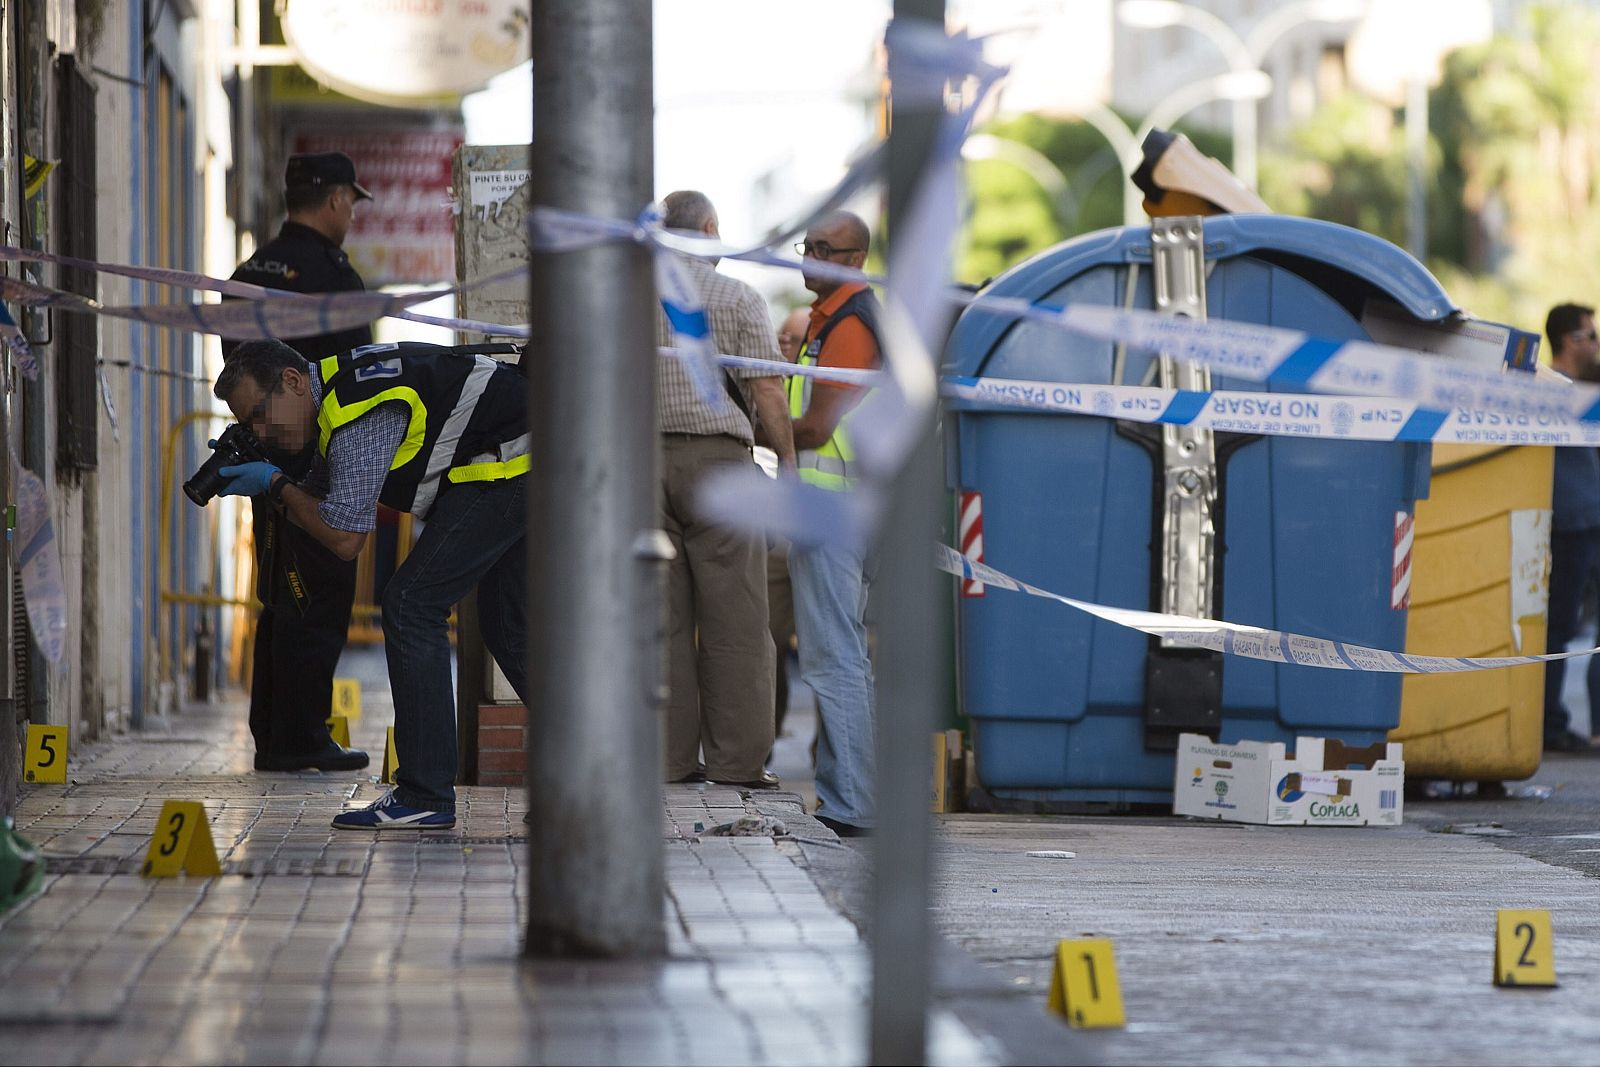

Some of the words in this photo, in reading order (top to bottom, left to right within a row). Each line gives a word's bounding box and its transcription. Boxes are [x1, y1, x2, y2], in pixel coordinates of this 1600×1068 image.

[474, 174, 501, 183] PINTE
[504, 173, 516, 182] SU
[491, 185, 507, 193] POR
[1053, 388, 1082, 406] NO
[1121, 400, 1162, 411] CNP
[1213, 399, 1282, 416] PASAR
[1289, 401, 1319, 418] NO
[1360, 409, 1403, 422] CNP
[1457, 406, 1530, 426] PASAR
[1263, 422, 1281, 431] DE
[1455, 430, 1507, 441] POLICIA
[1511, 431, 1529, 440] DE
[1531, 431, 1570, 443] LINEA
[287, 571, 305, 600] Nikon
[37, 734, 57, 768] 5
[160, 812, 185, 857] 3
[1514, 922, 1537, 968] 2
[1082, 952, 1100, 1002] 1
